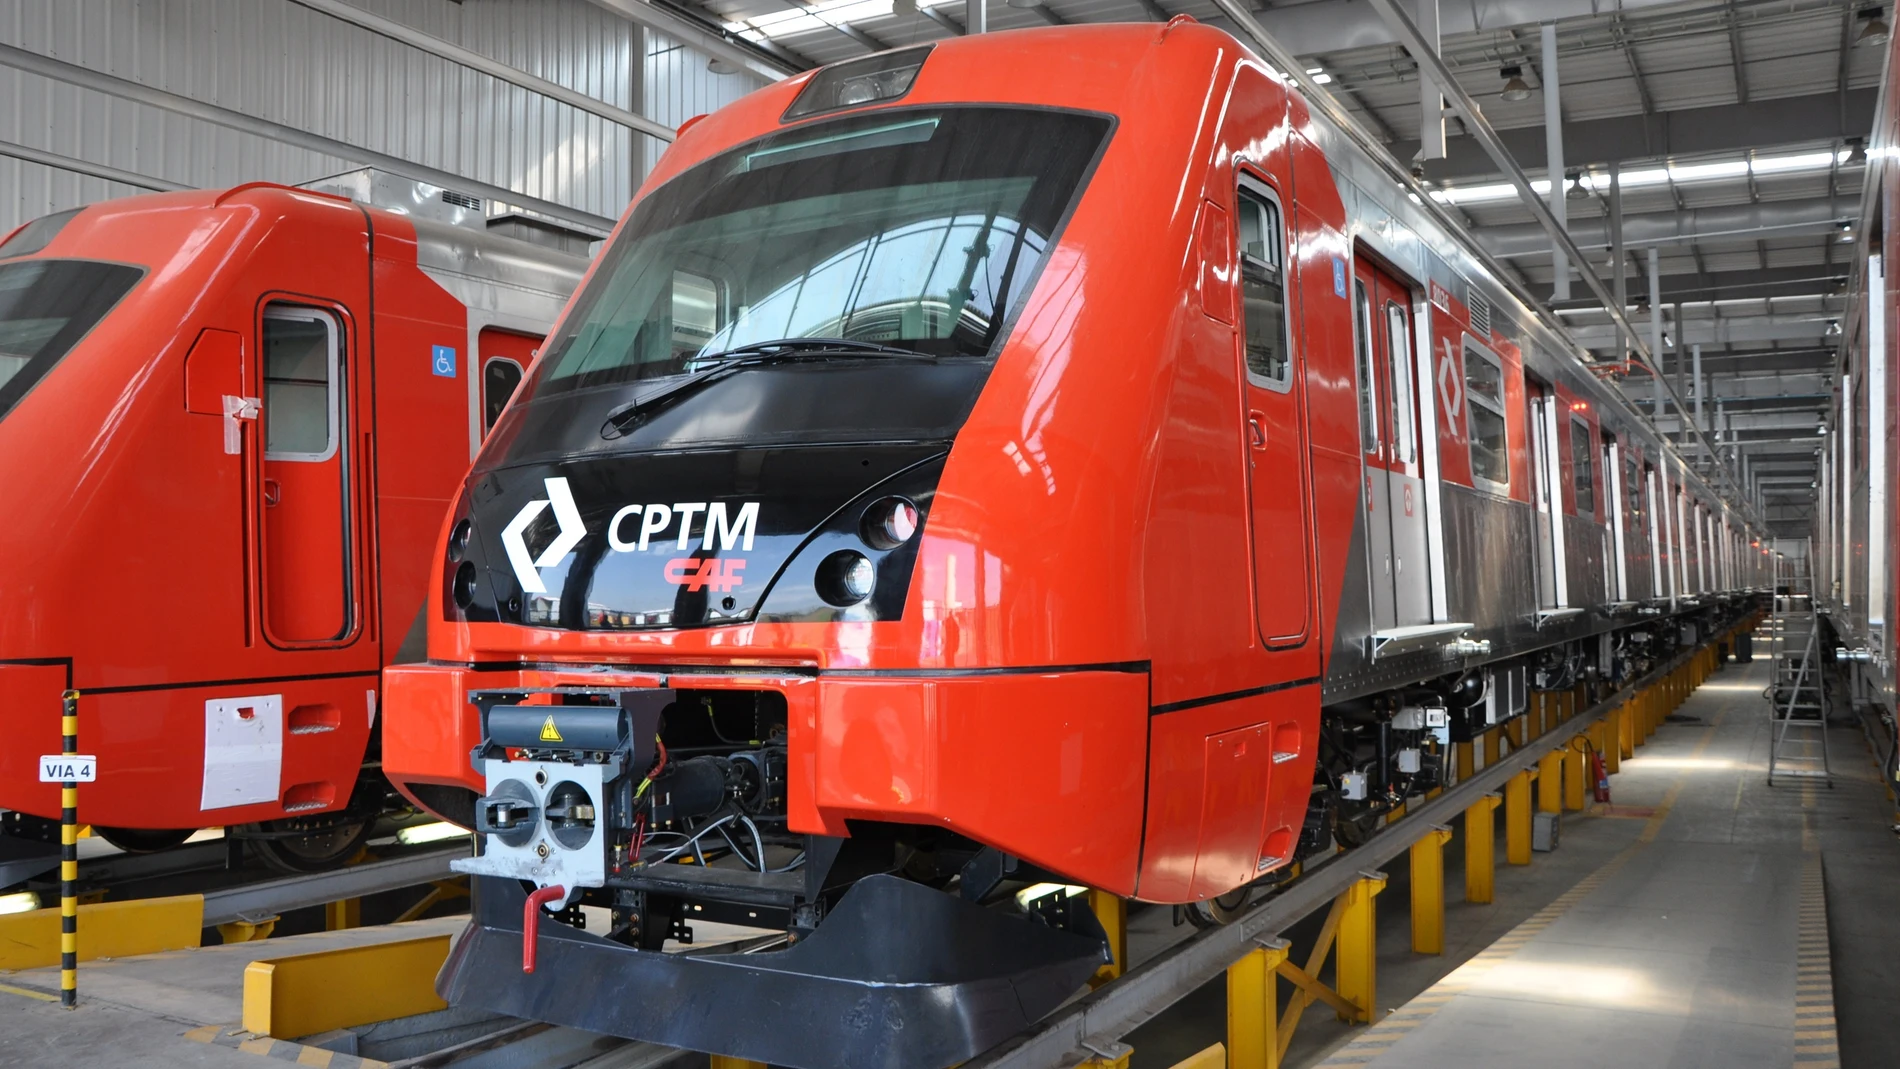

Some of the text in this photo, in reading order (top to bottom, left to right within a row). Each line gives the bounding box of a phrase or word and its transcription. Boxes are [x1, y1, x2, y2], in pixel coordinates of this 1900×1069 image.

[607, 502, 760, 552] CPTM
[664, 558, 746, 592] CAF
[46, 764, 91, 778] VIA 4
